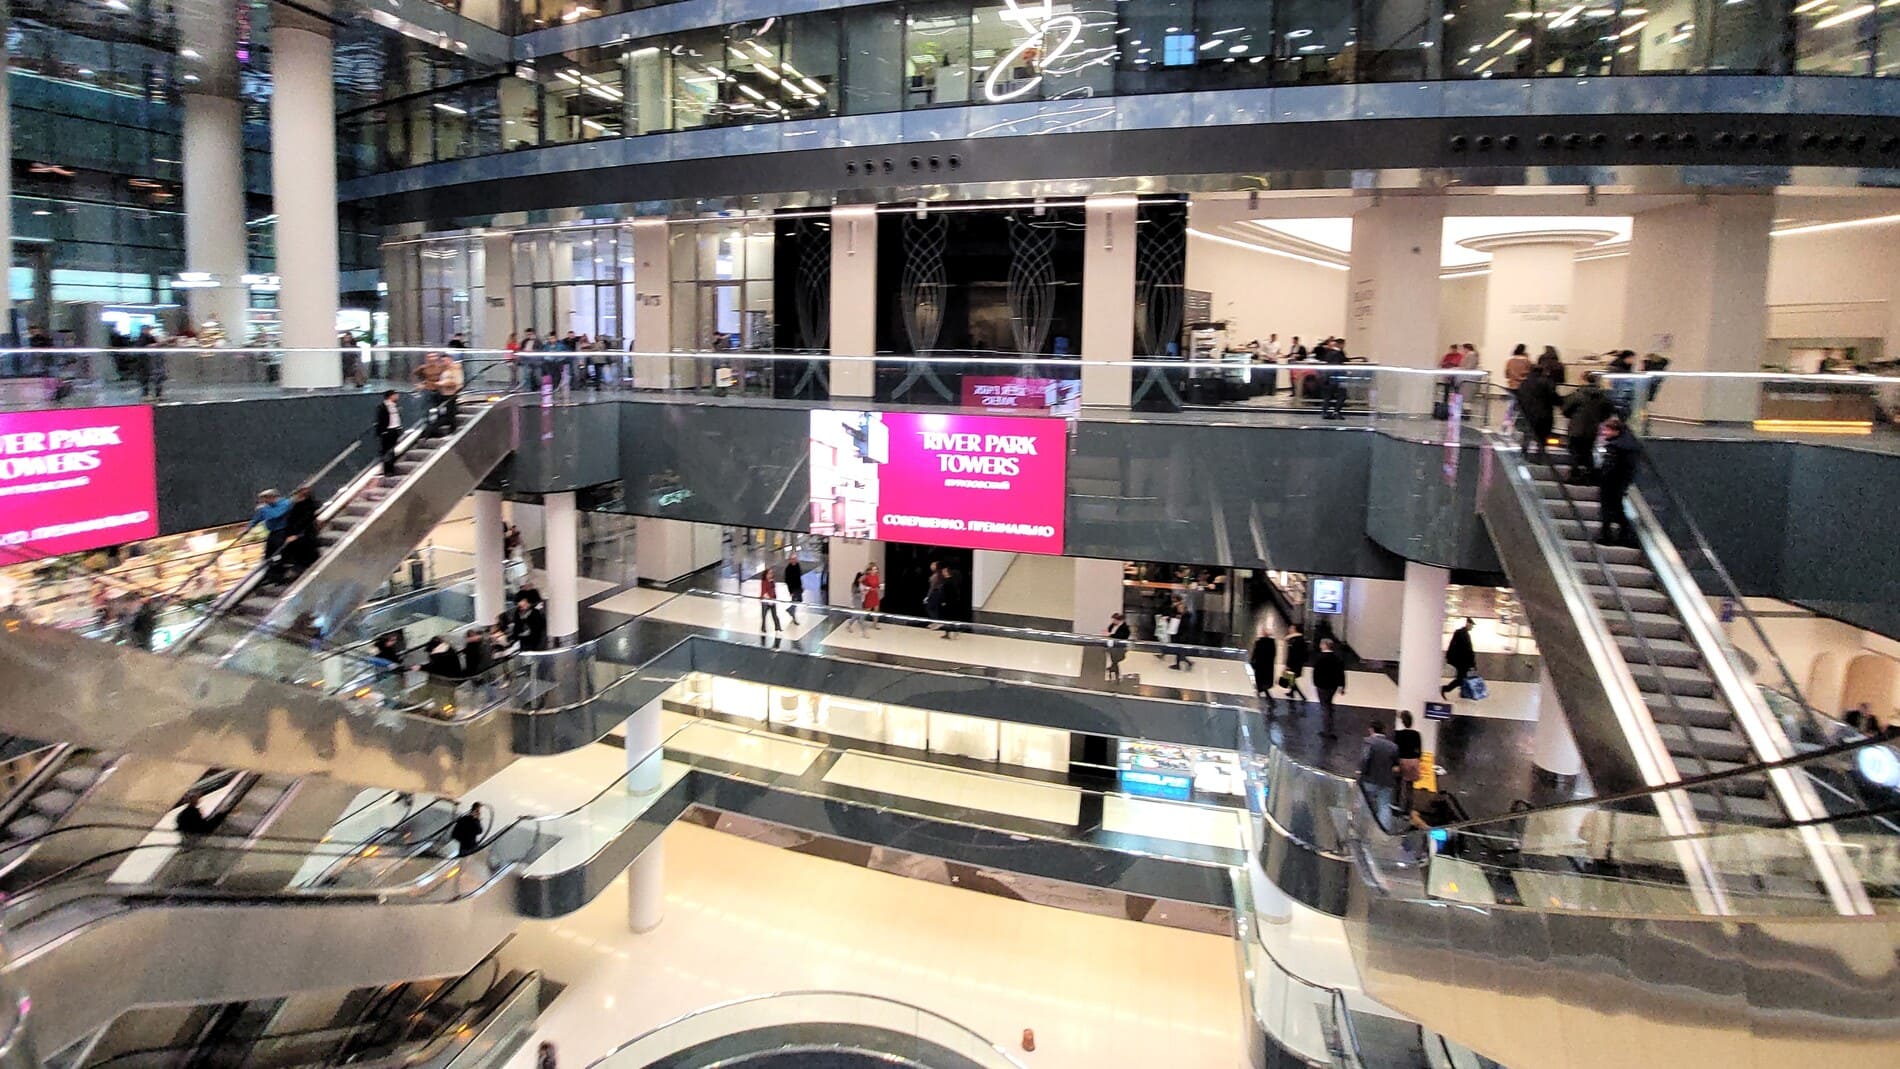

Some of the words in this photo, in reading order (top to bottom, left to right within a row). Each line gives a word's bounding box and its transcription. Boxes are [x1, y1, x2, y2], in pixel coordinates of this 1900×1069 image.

[48, 425, 122, 451] PARK
[915, 431, 982, 452] RIVER
[984, 434, 1038, 455] PARK
[936, 453, 1020, 476] TOWERS
[968, 520, 1055, 537] ПРЕМИАЛЬНО
